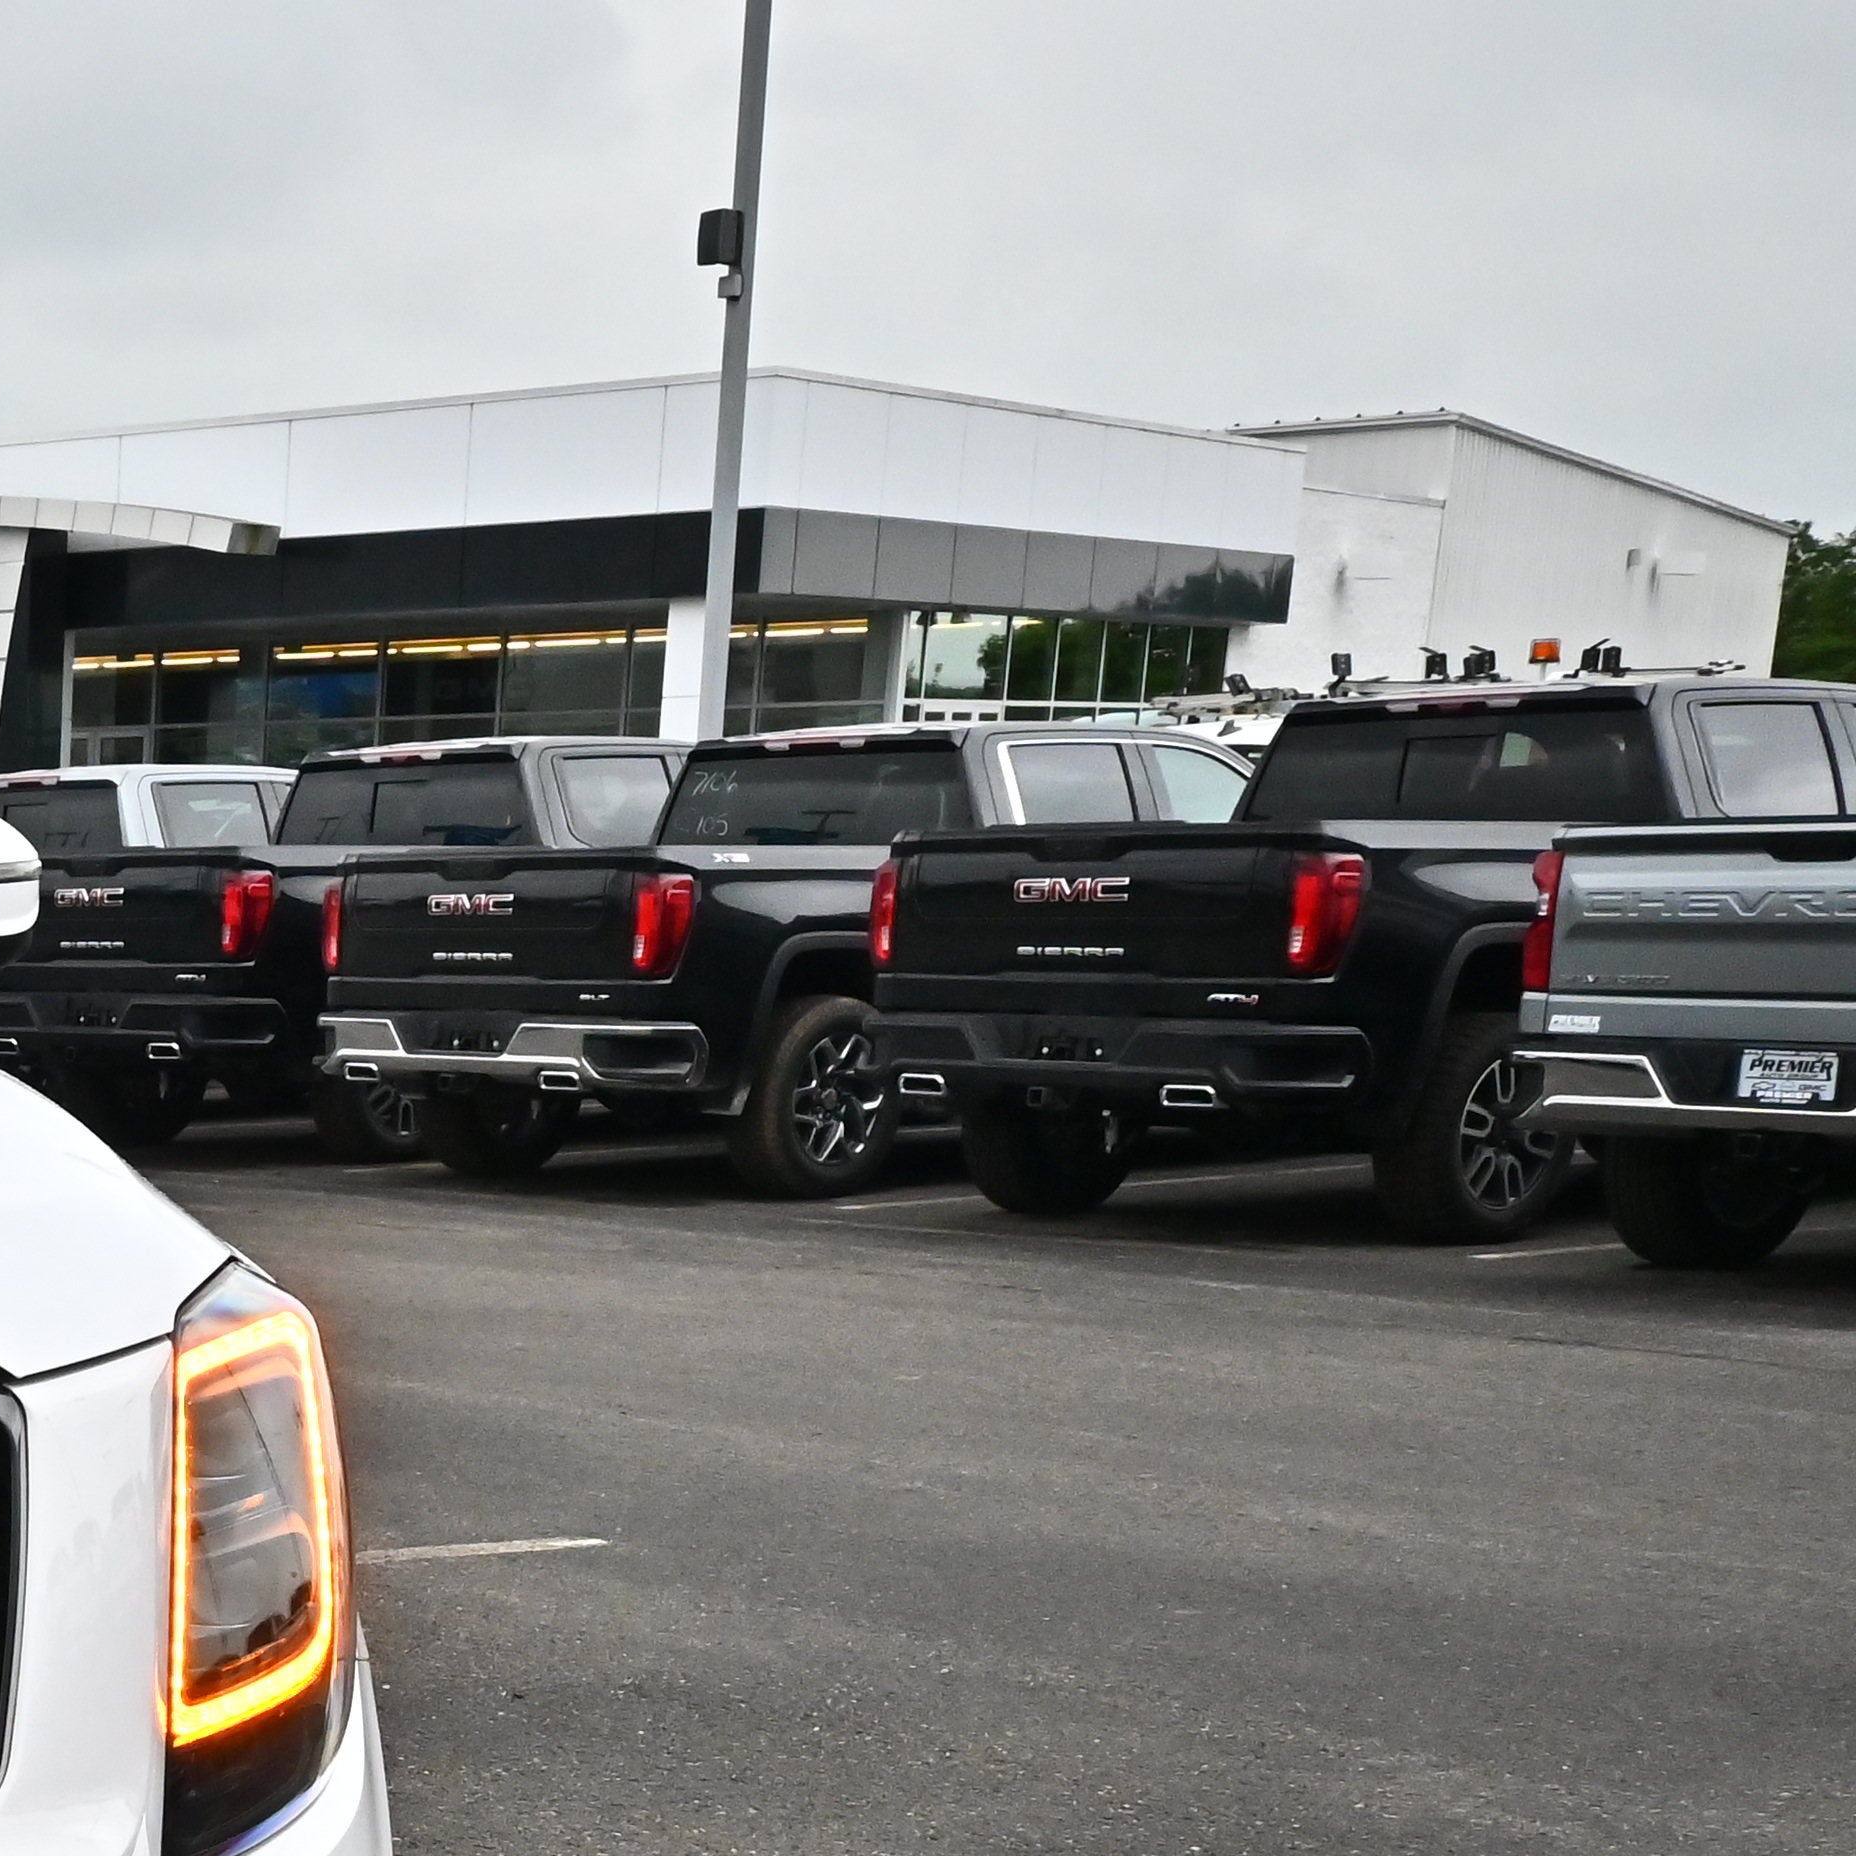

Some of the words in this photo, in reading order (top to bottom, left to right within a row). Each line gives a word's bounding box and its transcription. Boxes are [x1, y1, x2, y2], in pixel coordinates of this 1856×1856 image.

[53, 886, 125, 908] GMC
[1013, 876, 1131, 903] GMC
[426, 893, 515, 917] GMC
[432, 951, 514, 962] SIERRA
[1015, 945, 1125, 957] SIERRA
[1749, 1058, 1834, 1081] PREMIER
